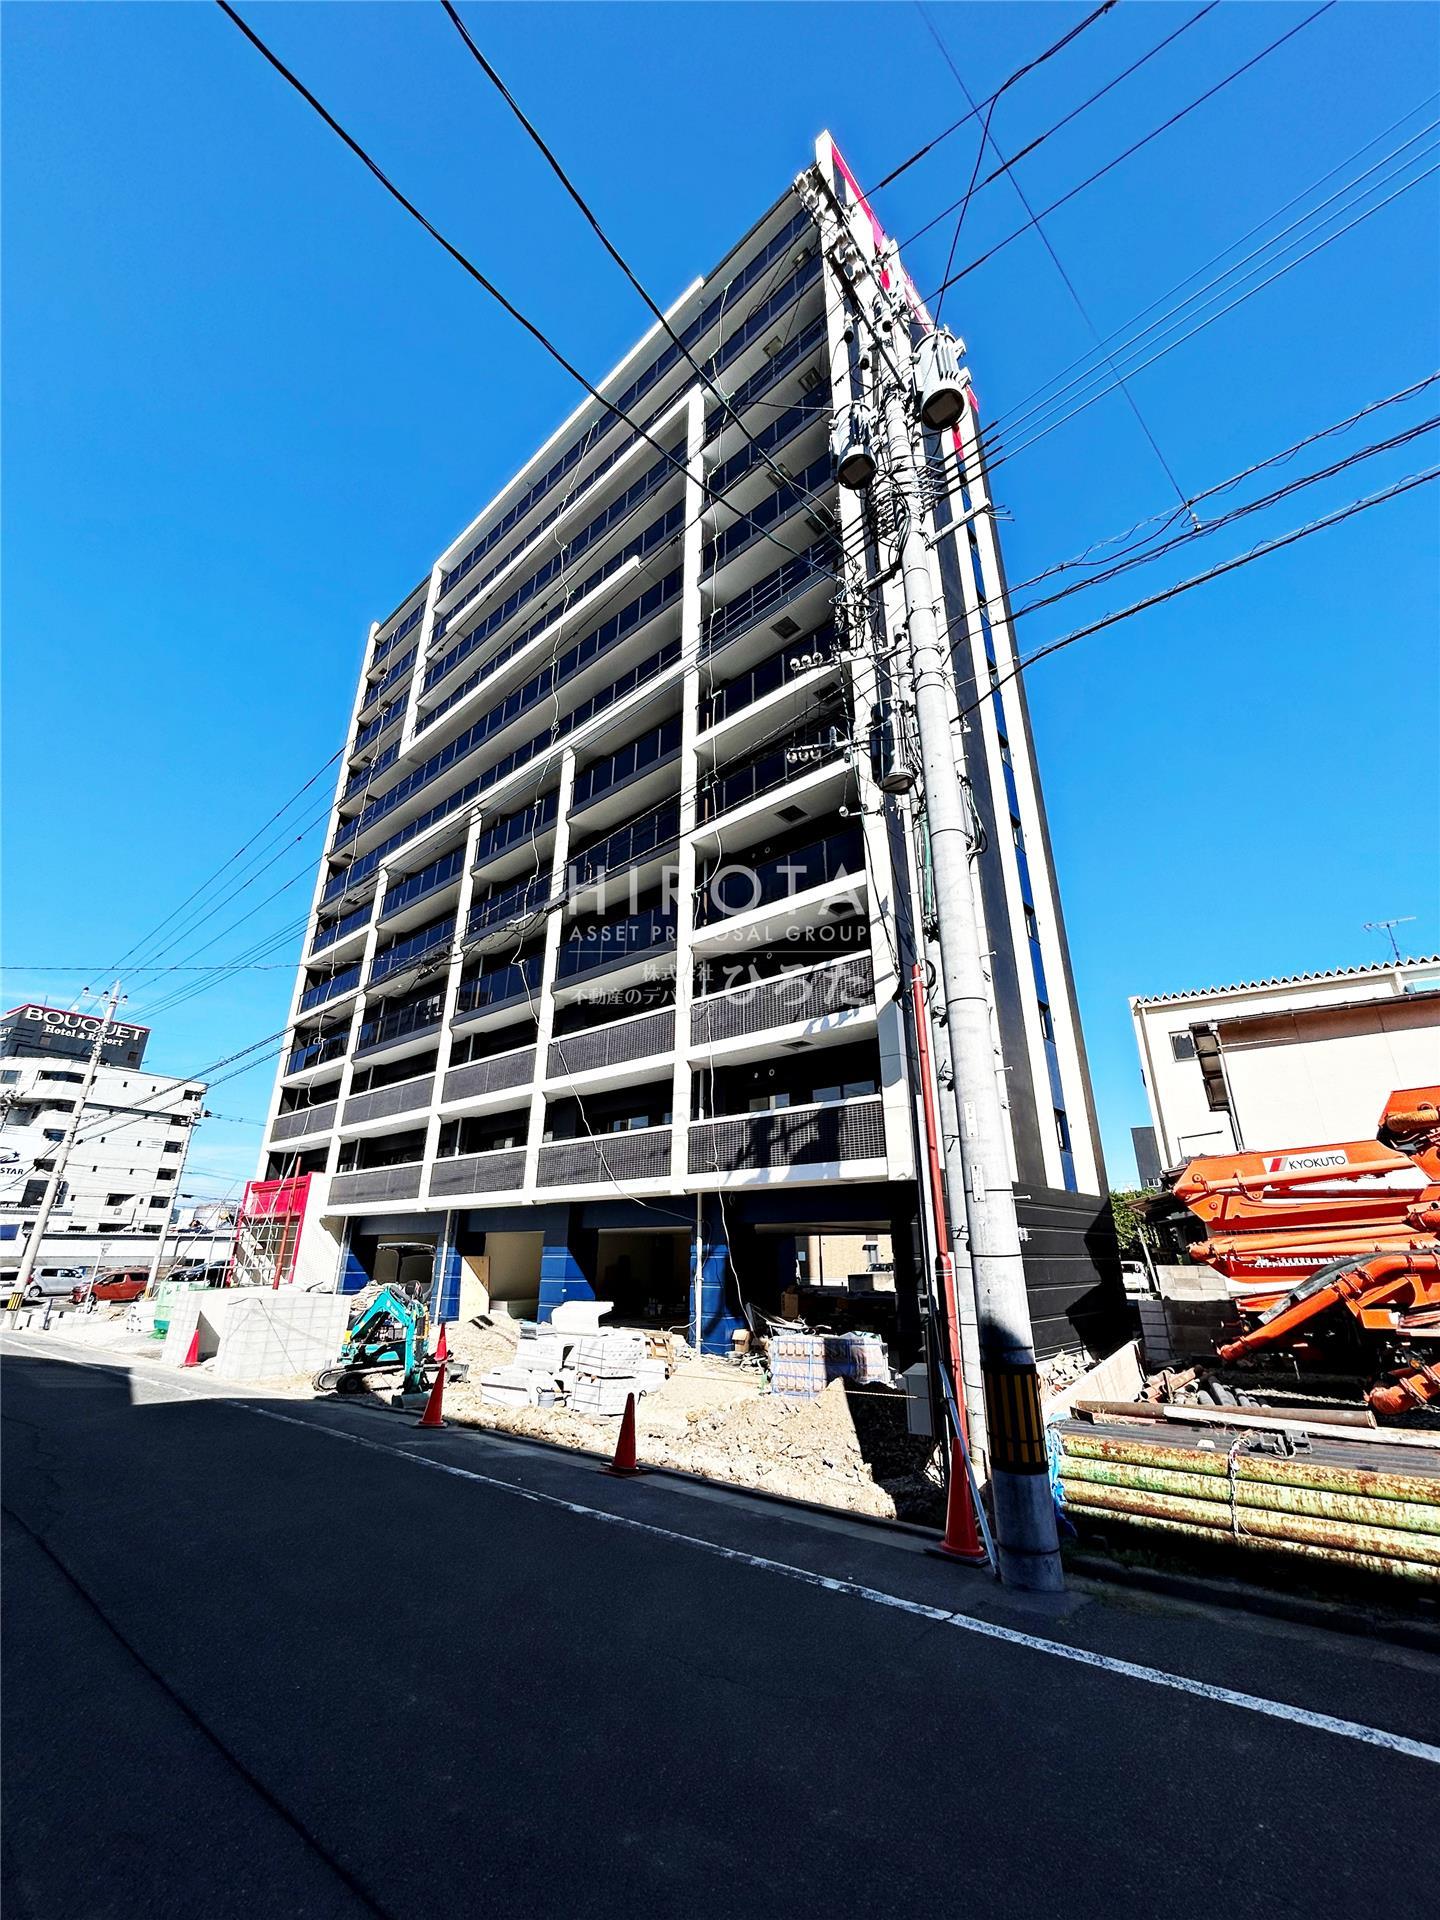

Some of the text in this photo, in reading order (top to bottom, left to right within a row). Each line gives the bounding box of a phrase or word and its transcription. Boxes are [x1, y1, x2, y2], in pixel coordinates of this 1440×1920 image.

[25, 1006, 146, 1041] BOUQUET
[44, 1024, 124, 1047] Hotel & Rort
[1289, 1156, 1346, 1169] KYOKUTO
